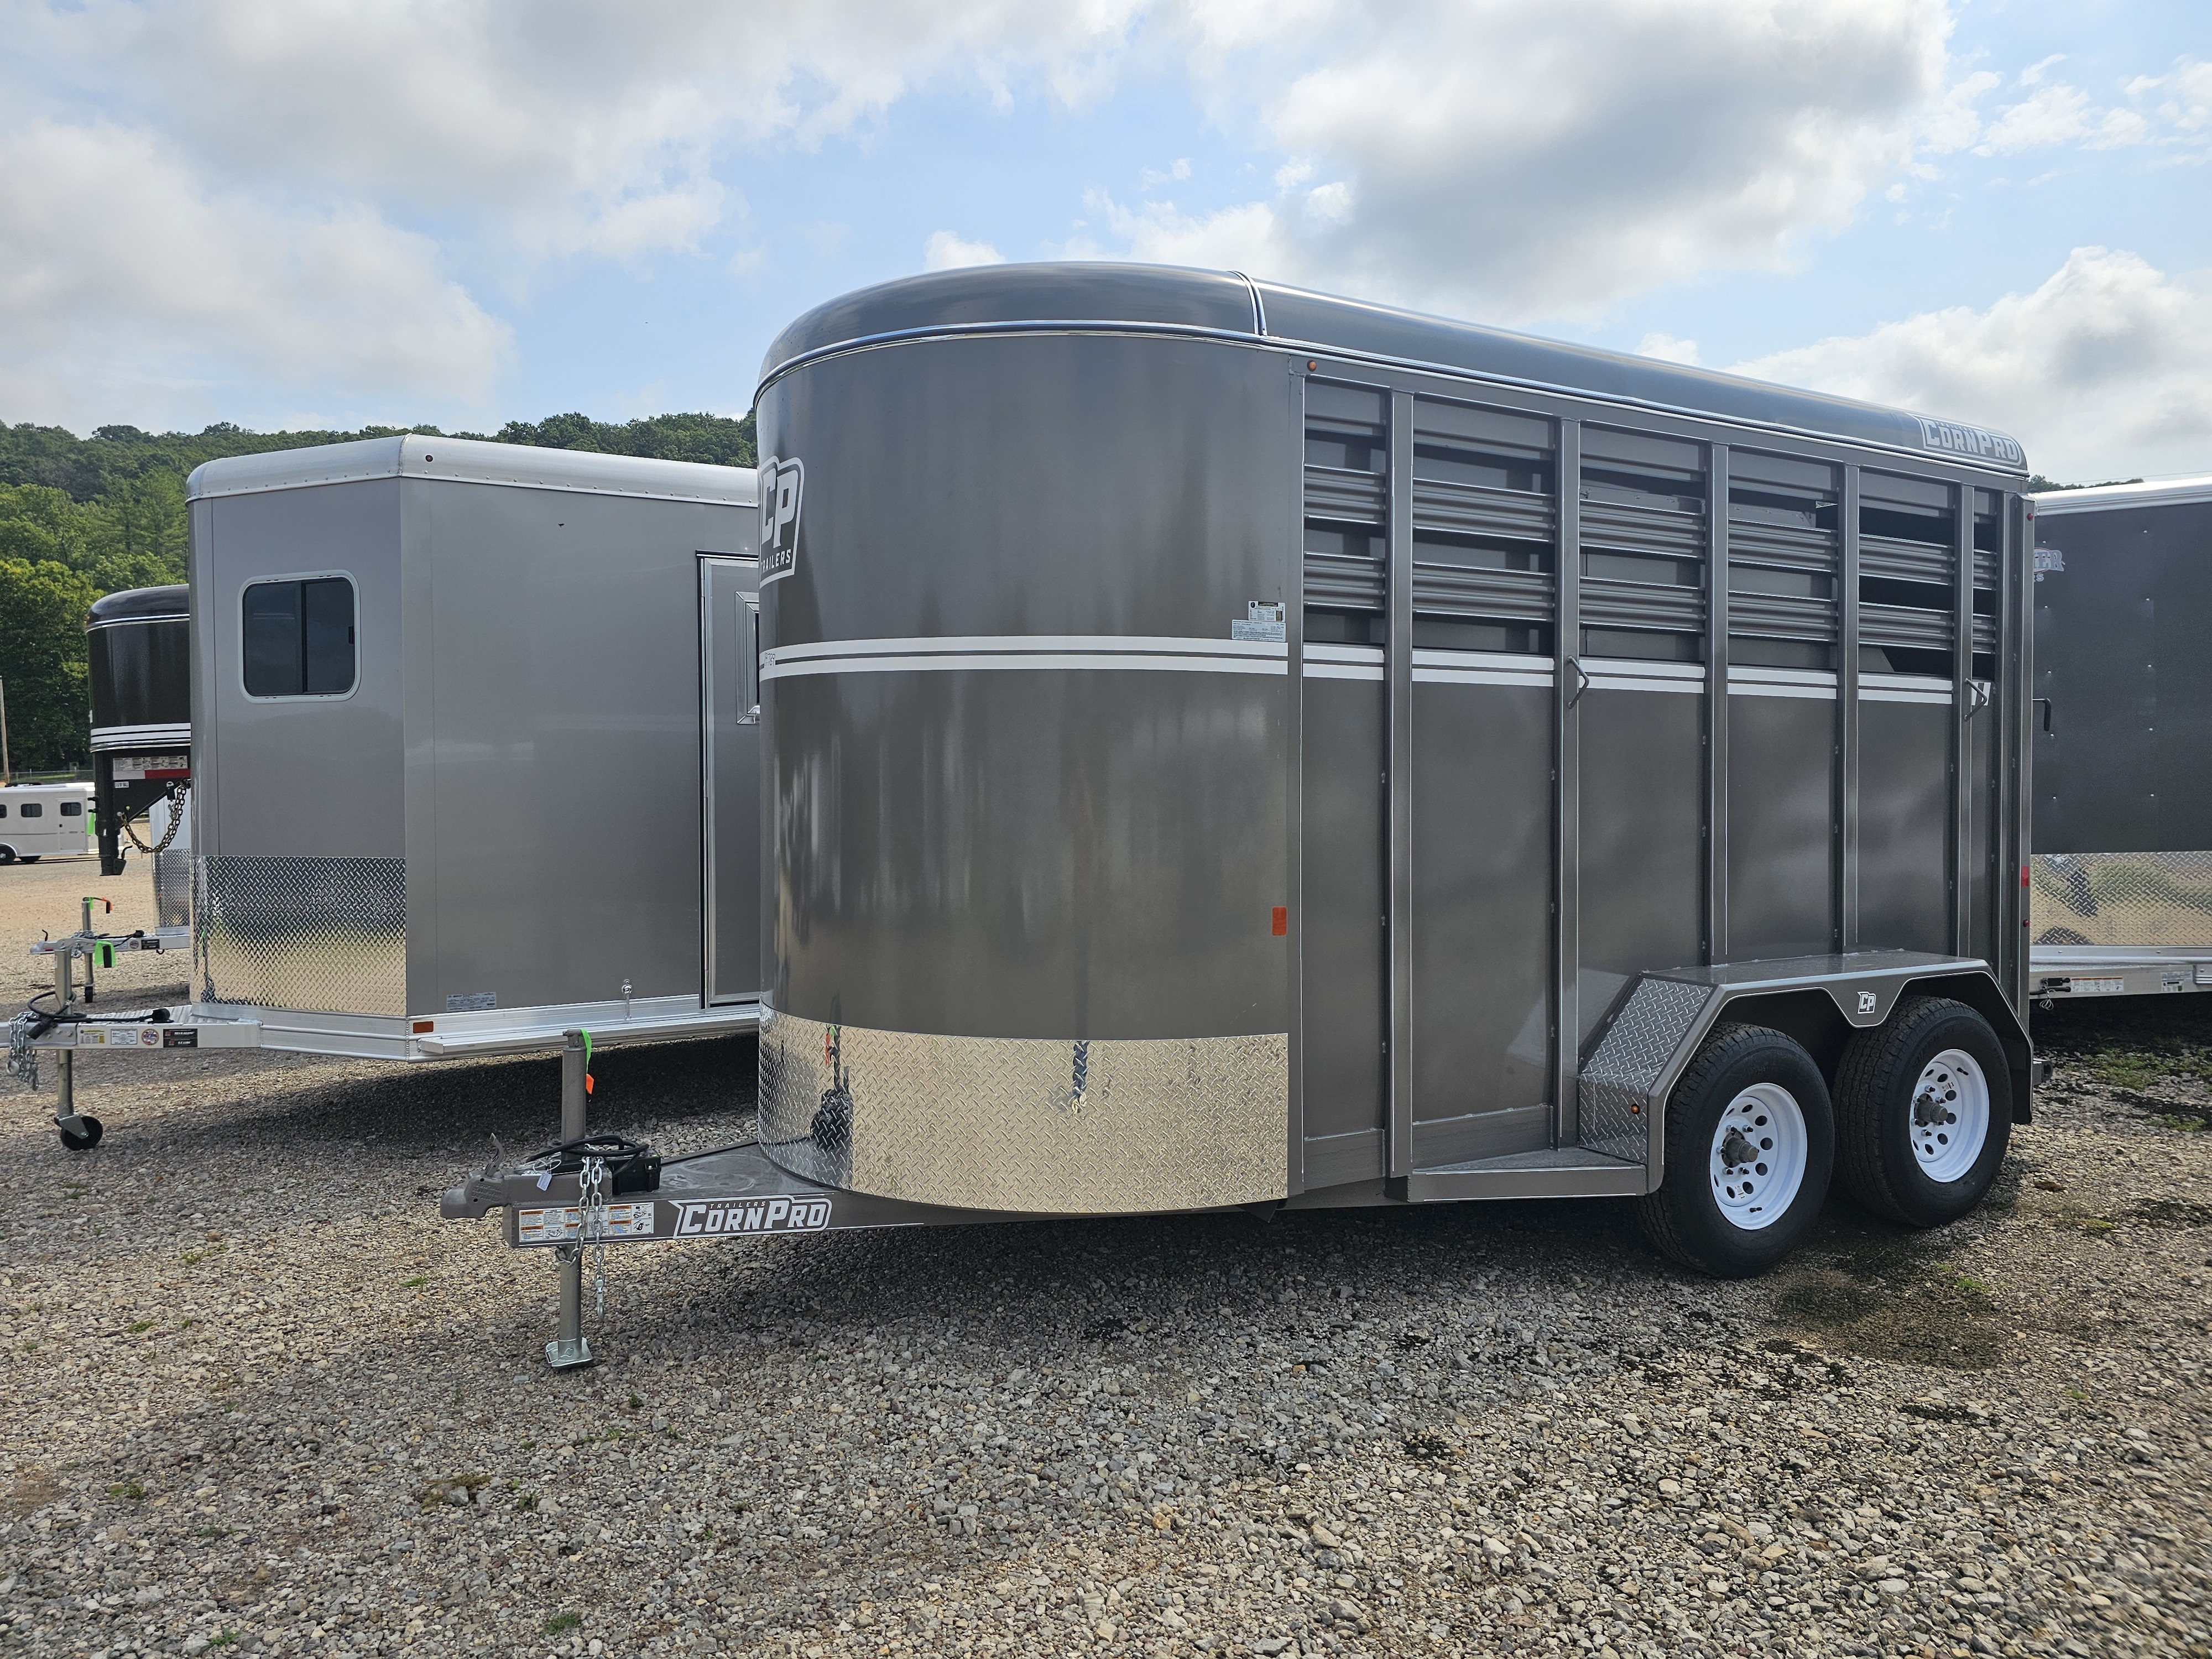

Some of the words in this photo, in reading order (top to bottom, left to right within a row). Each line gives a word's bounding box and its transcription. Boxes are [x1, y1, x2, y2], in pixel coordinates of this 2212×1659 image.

[761, 468, 799, 549] CP
[2034, 550, 2064, 571] ER
[1860, 994, 1875, 1011] CP
[710, 1201, 766, 1209] TRAILERS
